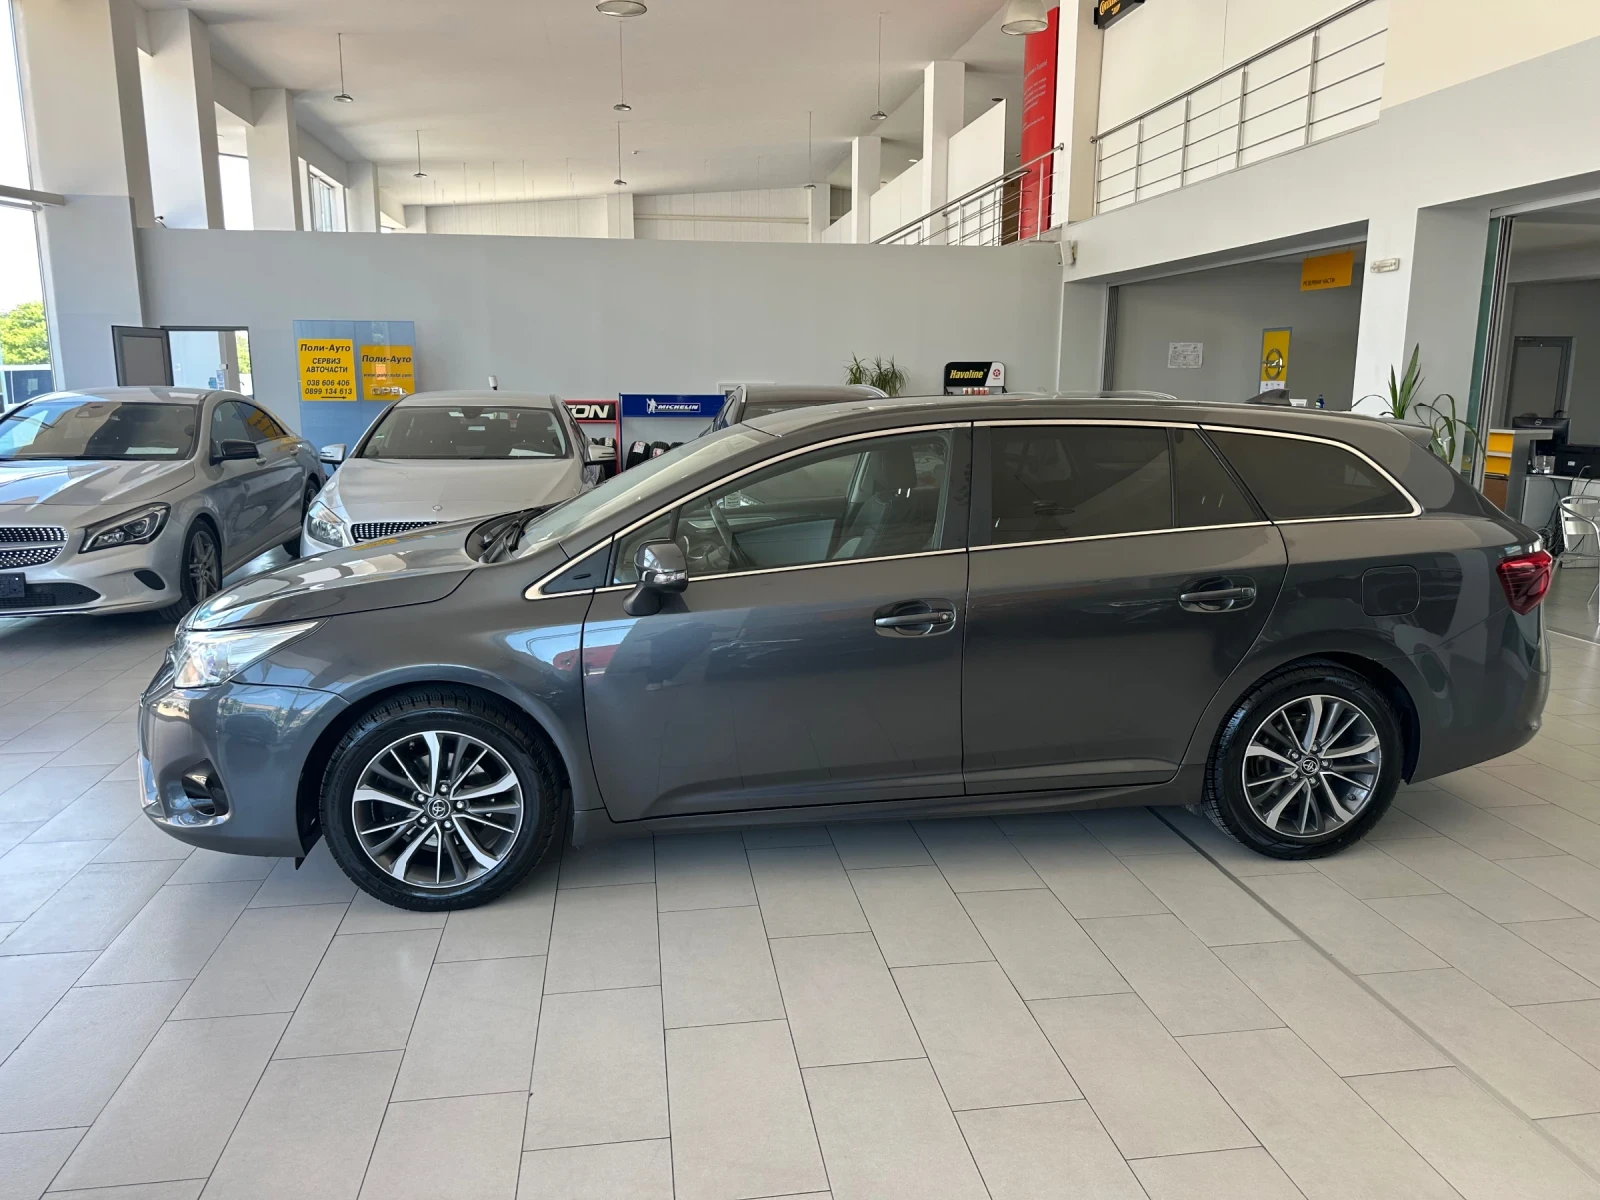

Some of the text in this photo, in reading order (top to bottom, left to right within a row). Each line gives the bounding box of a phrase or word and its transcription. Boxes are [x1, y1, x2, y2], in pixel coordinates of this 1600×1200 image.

[300, 343, 351, 353] Поли-Ауто
[312, 357, 341, 365] СЕРВИЗ
[361, 354, 412, 365] Поли-Ауто
[949, 369, 984, 379] Havoline
[371, 386, 407, 395] OPEL
